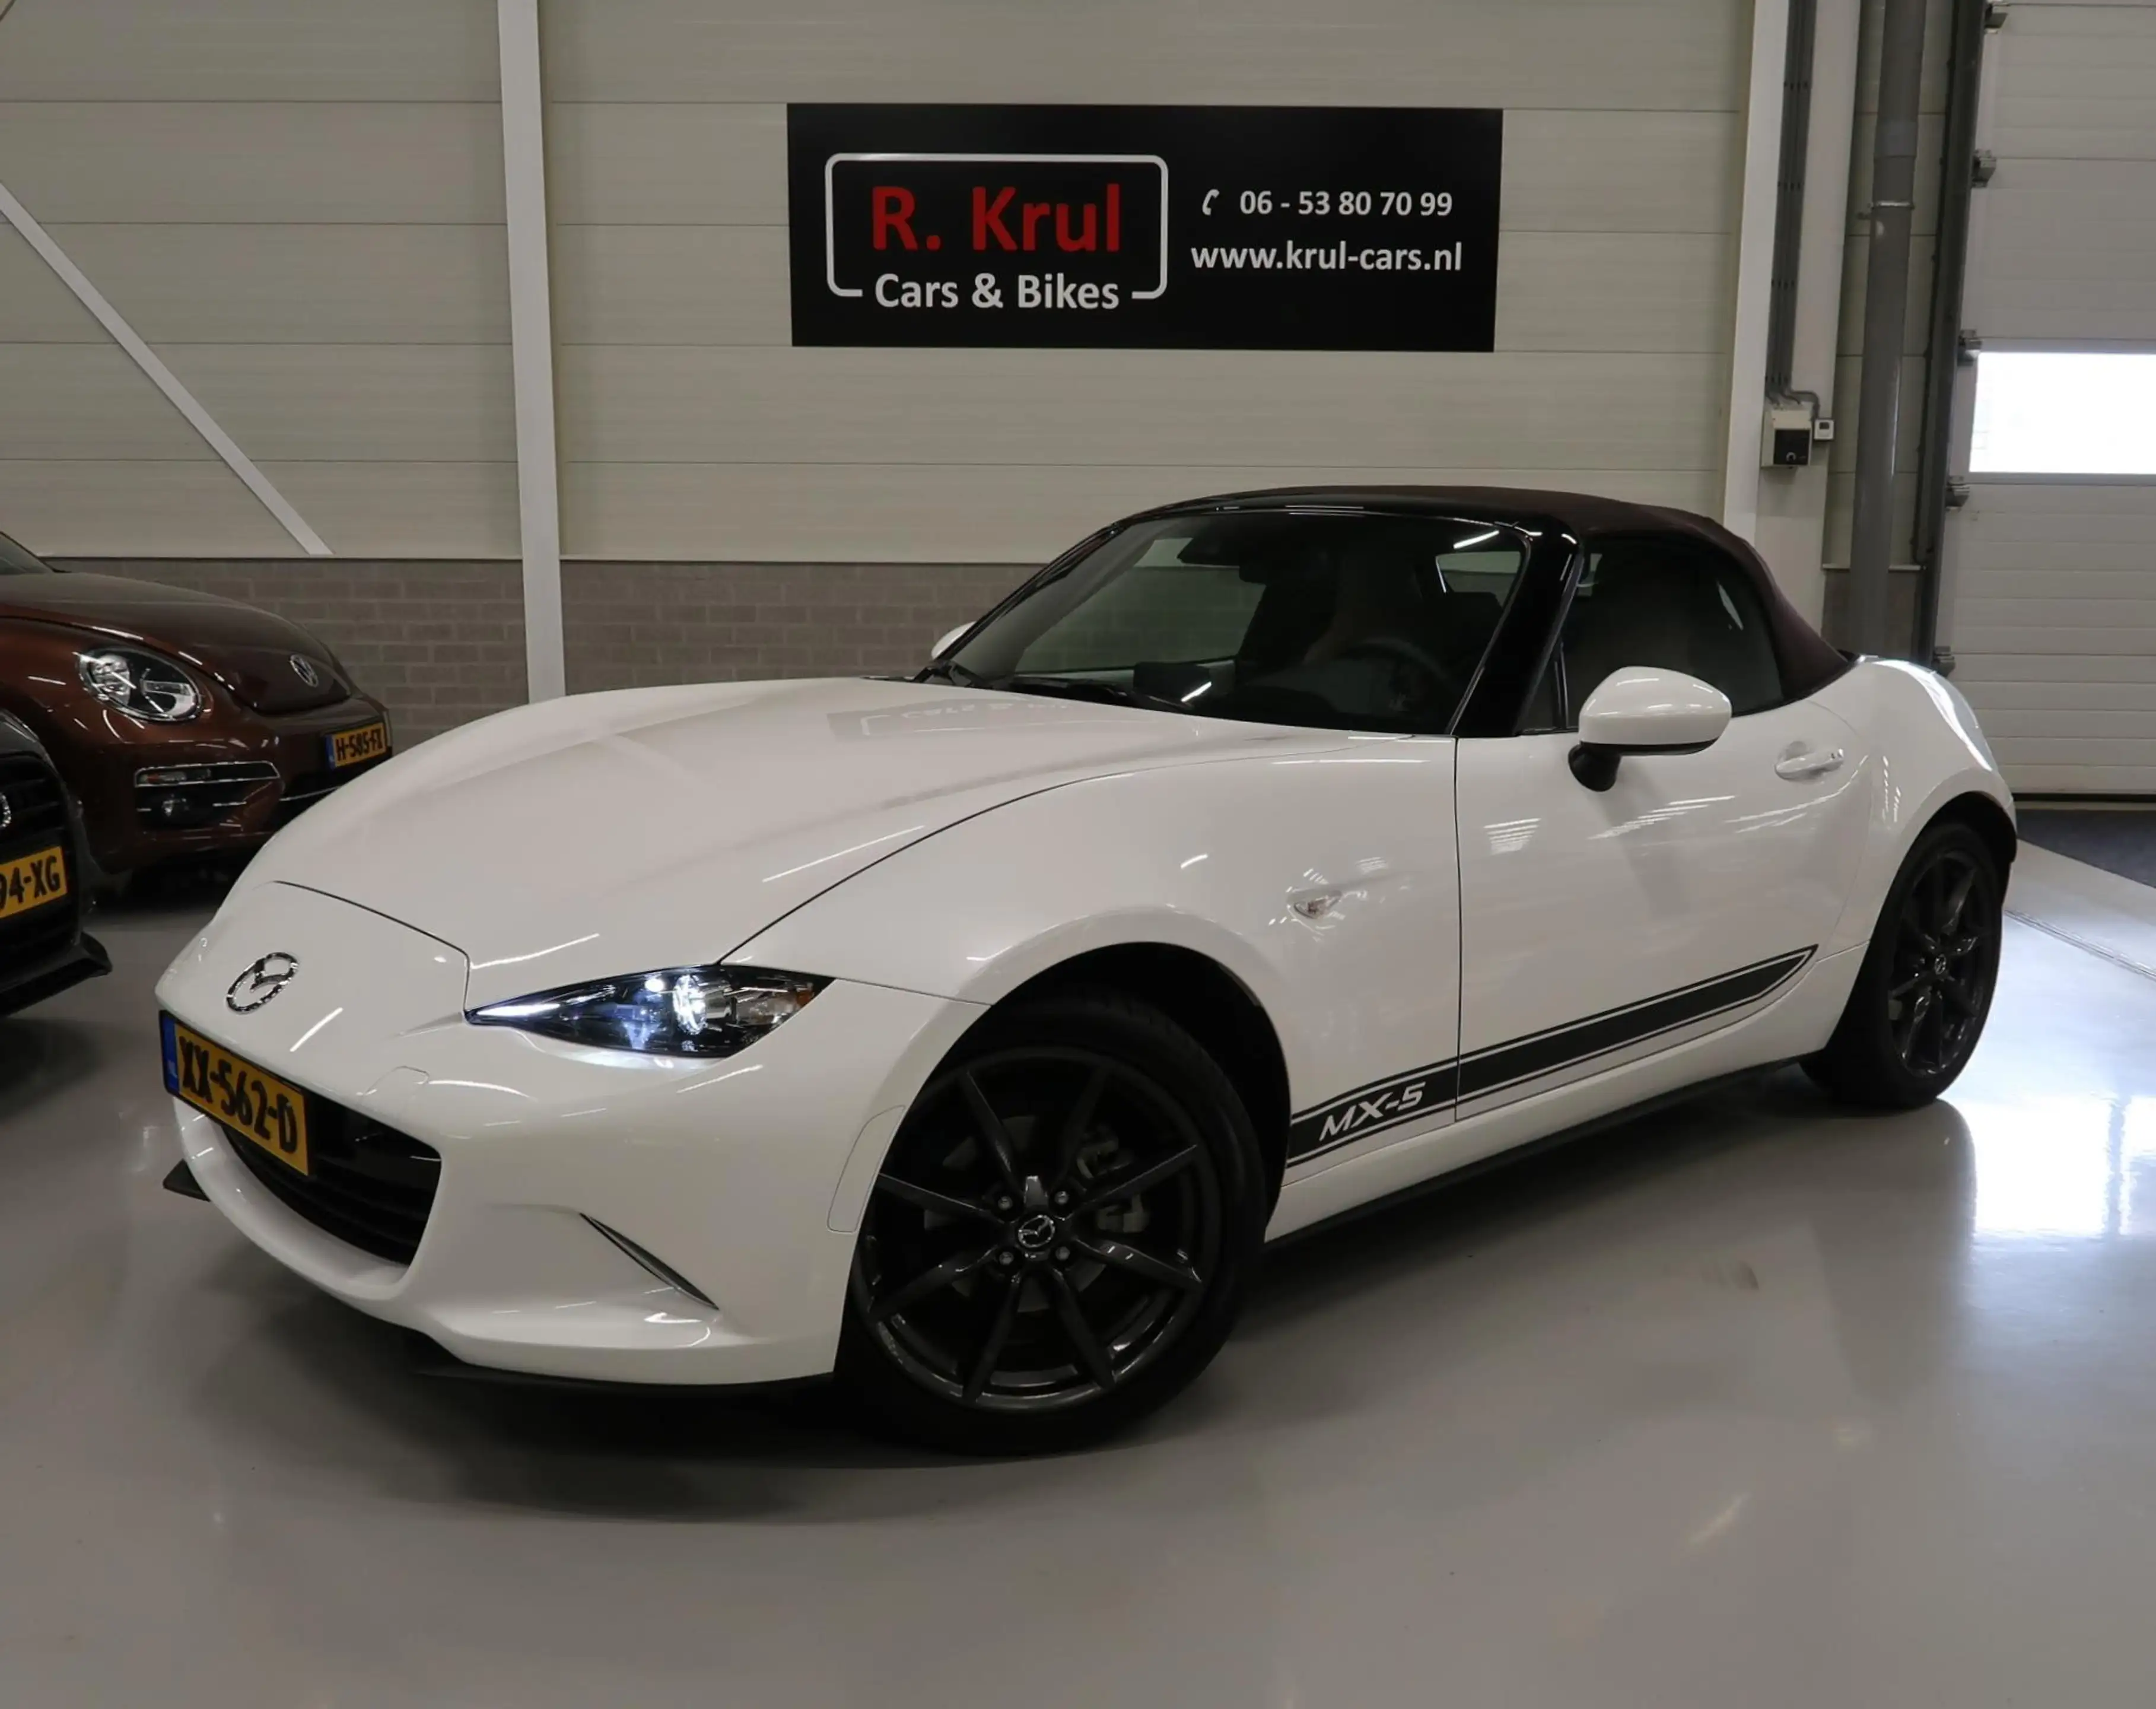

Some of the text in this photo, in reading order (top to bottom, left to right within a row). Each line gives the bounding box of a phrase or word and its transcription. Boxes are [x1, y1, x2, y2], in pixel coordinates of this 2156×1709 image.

[872, 183, 1121, 253] R. Krul
[1240, 190, 1273, 215] 06
[1298, 191, 1330, 215] 53
[1338, 191, 1372, 216] 80
[1380, 192, 1412, 216] 70
[1420, 192, 1452, 216] 99
[1191, 240, 1462, 271] www.krul-cars.nl
[875, 272, 1119, 309] Cars & Bikes
[179, 1035, 297, 1154] XX-562-D
[1319, 1081, 1427, 1142] MX-5
